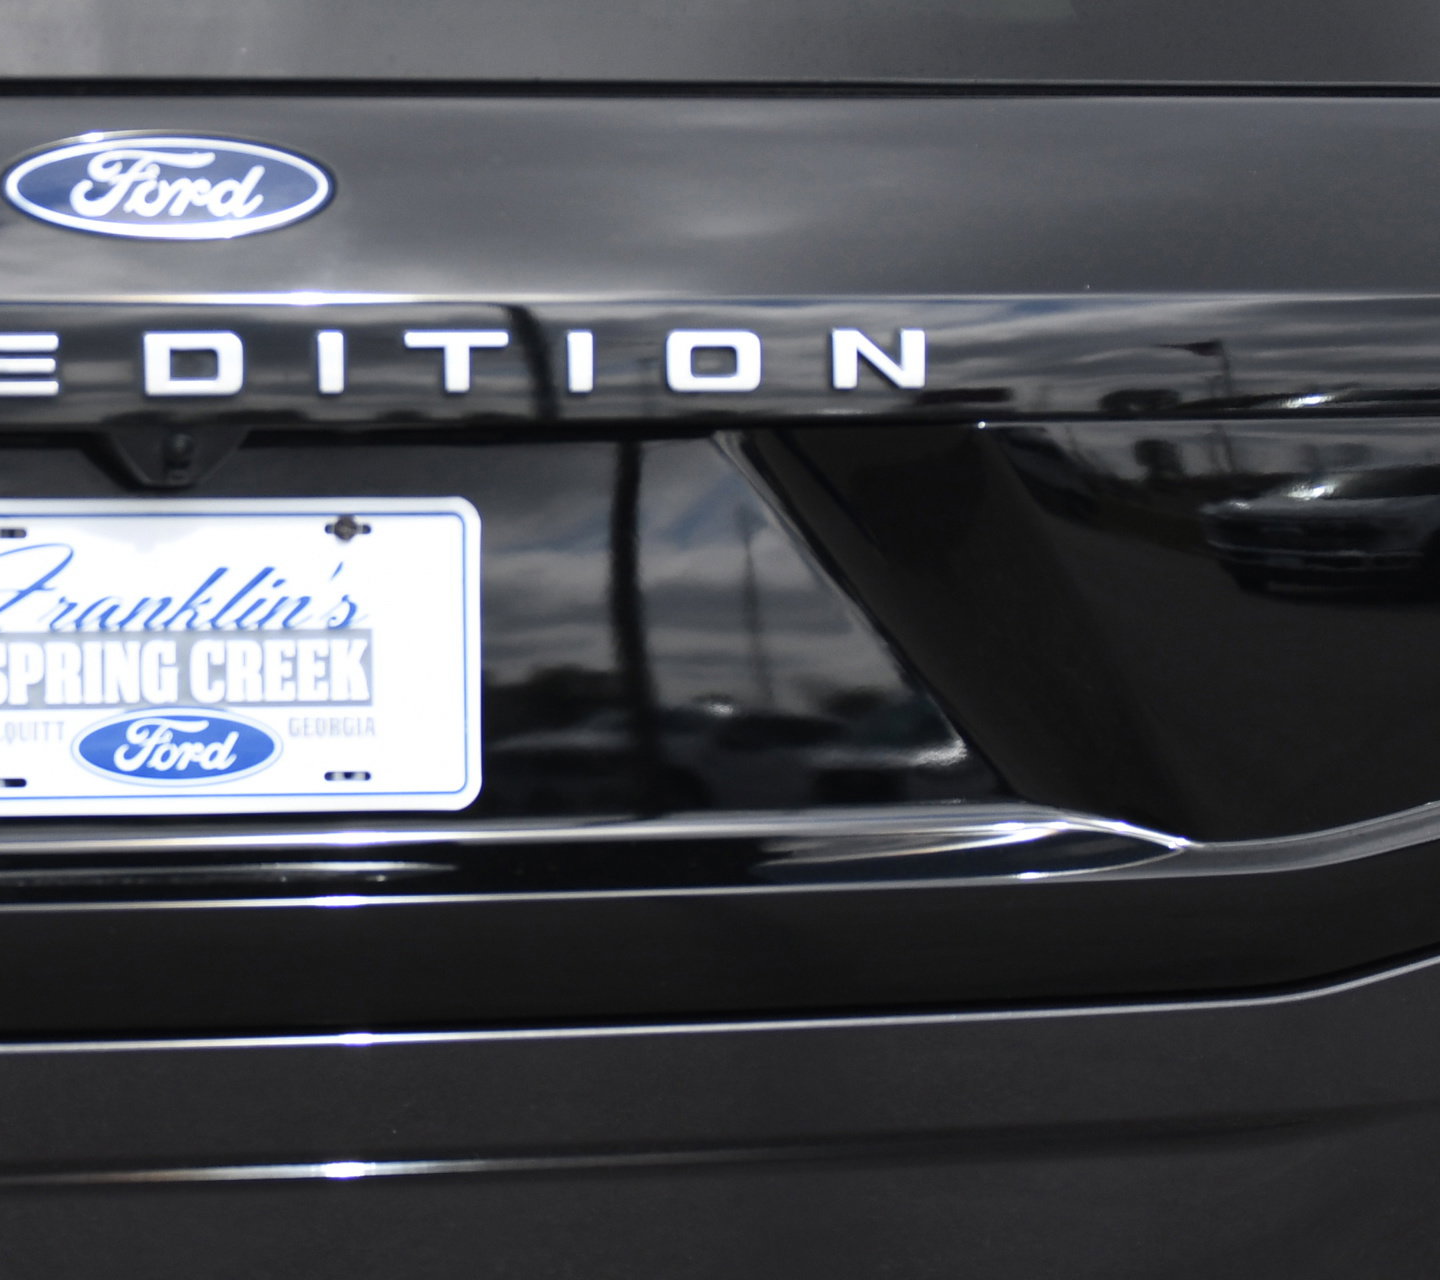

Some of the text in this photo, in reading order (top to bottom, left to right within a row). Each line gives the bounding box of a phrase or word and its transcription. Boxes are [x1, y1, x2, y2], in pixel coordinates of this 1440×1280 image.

[70, 148, 266, 219] Ford
[189, 636, 371, 705] CREEK
[113, 717, 238, 771] Ford
[288, 717, 376, 737] GEORGIA
